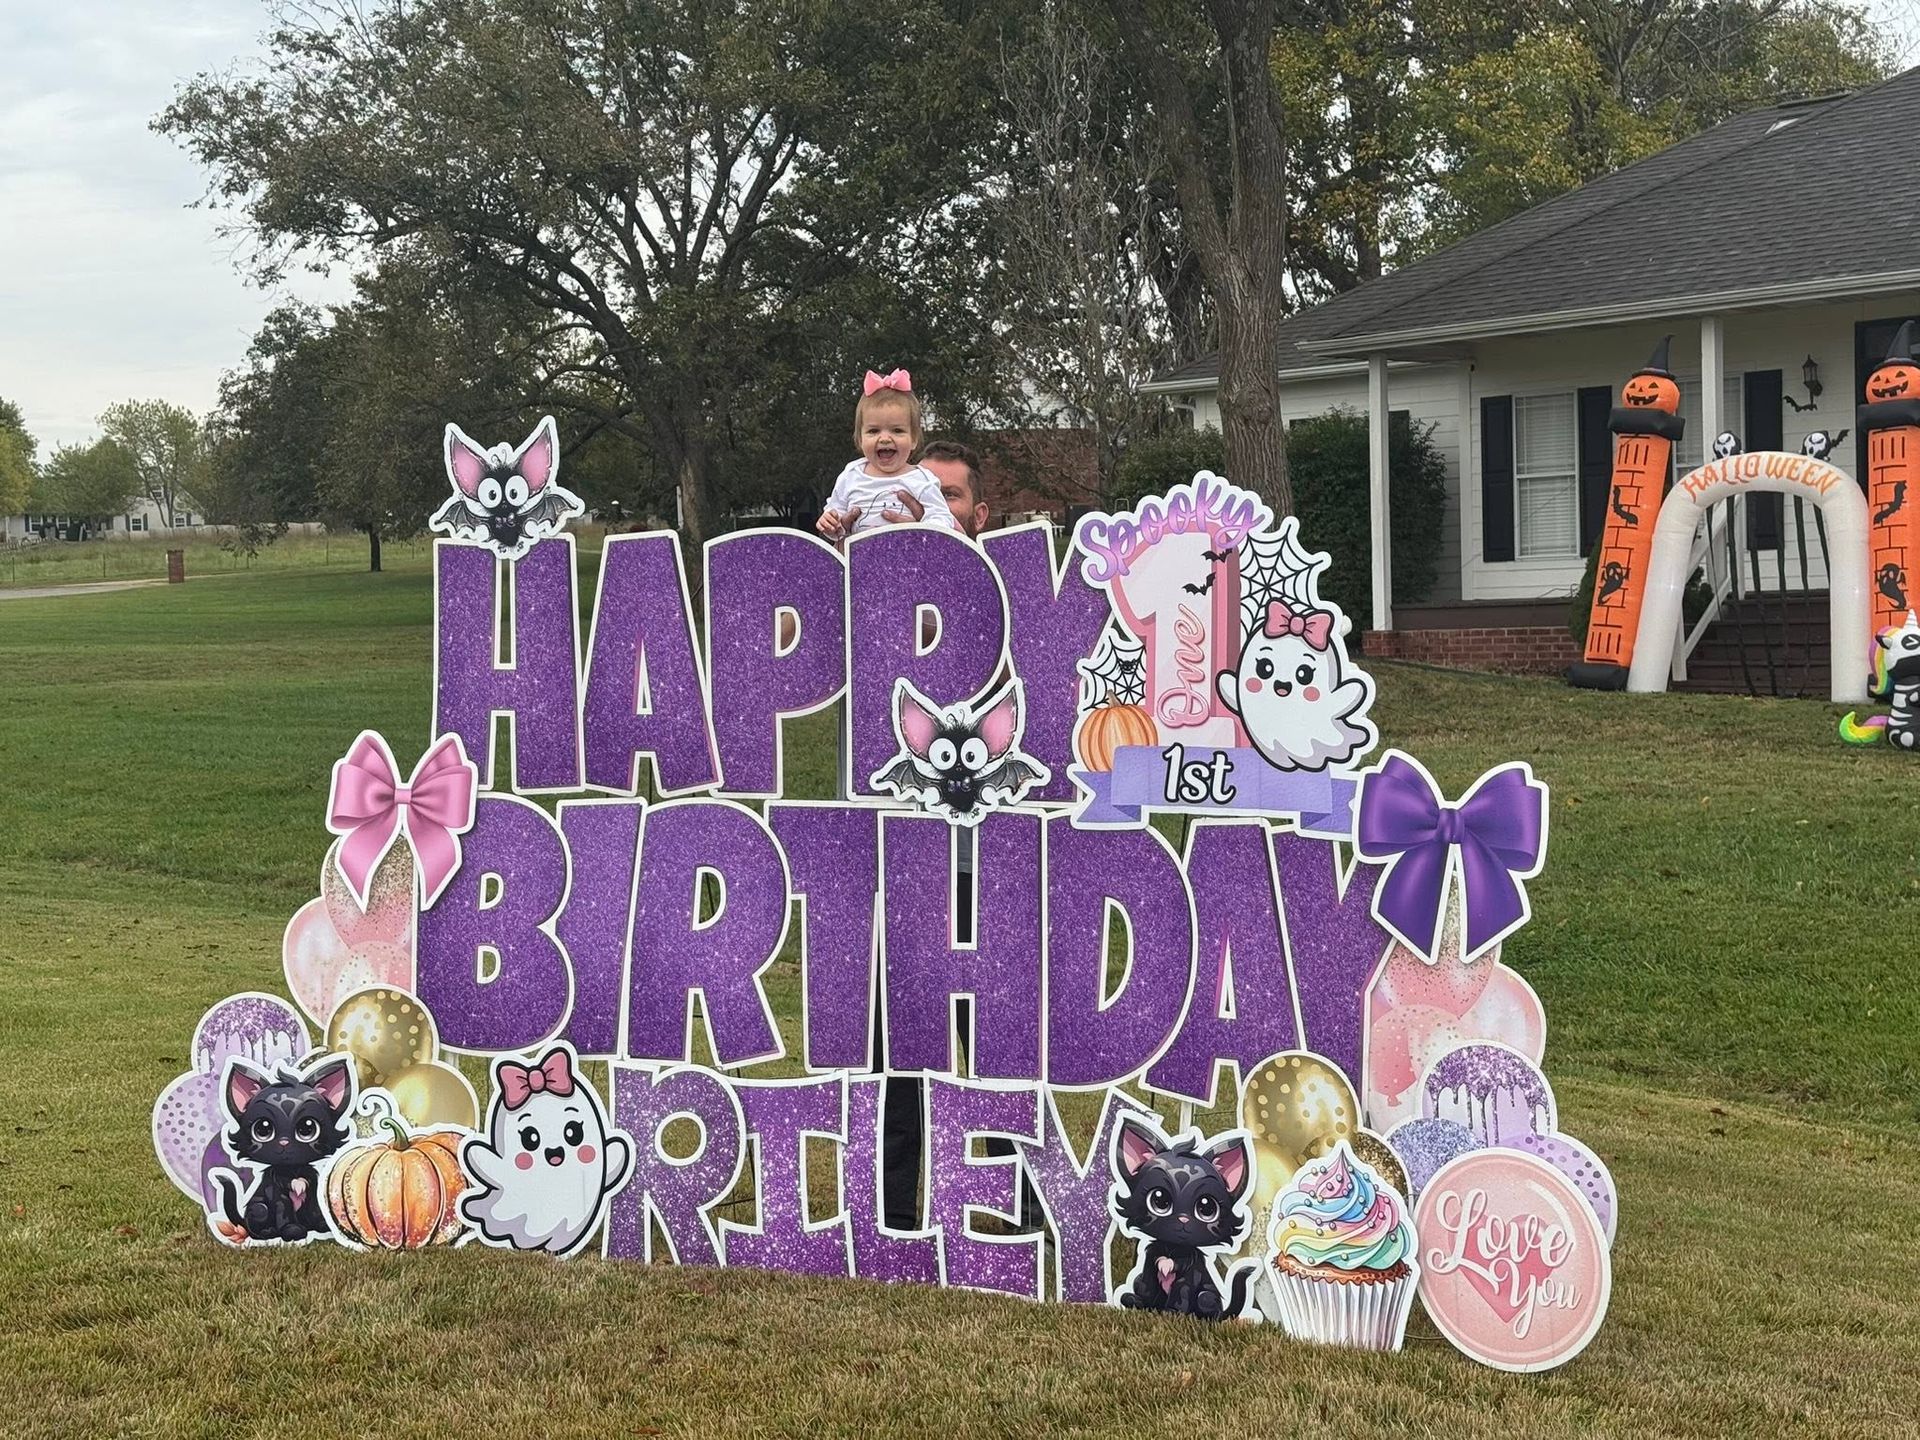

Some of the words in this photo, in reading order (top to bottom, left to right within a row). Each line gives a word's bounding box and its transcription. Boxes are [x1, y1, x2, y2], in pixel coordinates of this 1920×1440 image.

[1080, 478, 1265, 580] Spooky
[1683, 454, 1842, 500] HALLOWEEN
[434, 523, 1107, 800] HAPPY
[1156, 603, 1211, 729] One
[1162, 742, 1237, 804] 1st
[414, 793, 1390, 1107] BIRTHDAY
[603, 1060, 1155, 1304] RILEY
[1426, 1188, 1576, 1295] Love
[1489, 1258, 1583, 1339] You
